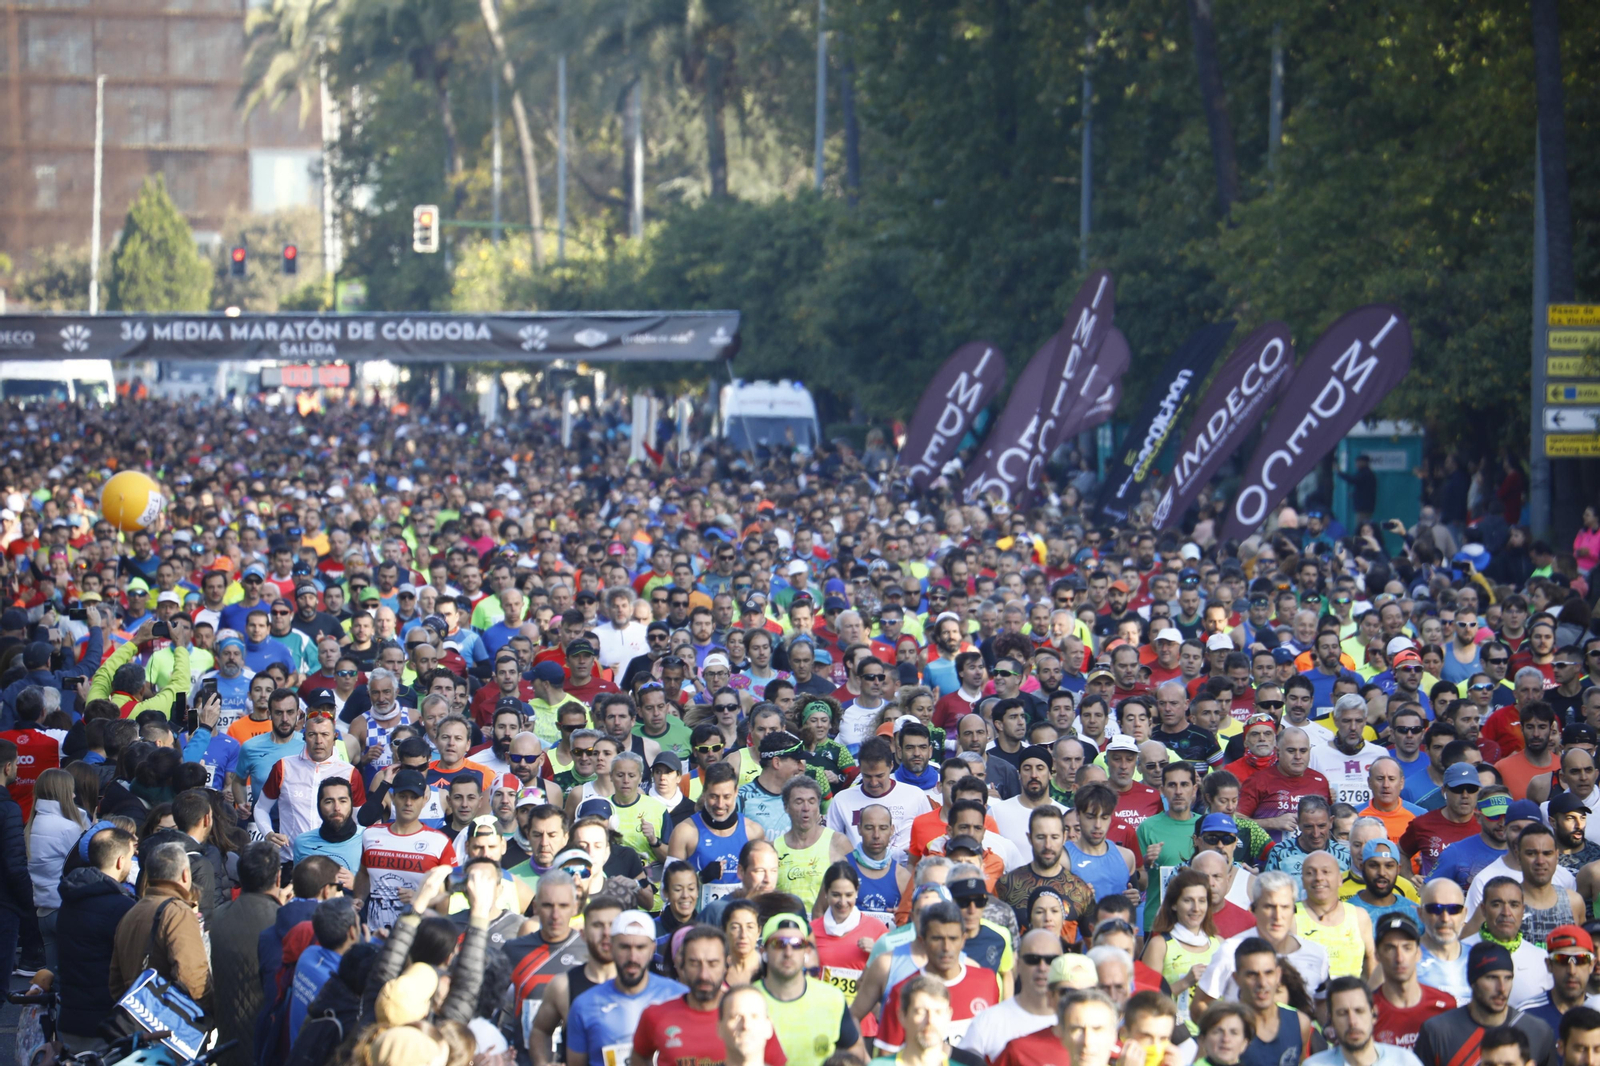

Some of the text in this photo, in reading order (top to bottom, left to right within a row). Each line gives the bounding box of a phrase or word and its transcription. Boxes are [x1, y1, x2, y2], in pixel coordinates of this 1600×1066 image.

[120, 317, 492, 341] 36 MEDIA MARATÓN DE CÓRDOBA
[279, 342, 336, 356] SALIDA
[1174, 337, 1285, 487] IMDECO
[1236, 313, 1398, 525] IMDECO
[293, 790, 304, 798] 36
[1339, 790, 1370, 802] 3769
[1277, 801, 1289, 810] 36
[1114, 809, 1139, 818] MEDIA
[395, 852, 425, 861] MARATÓN
[1429, 849, 1439, 857] 36
